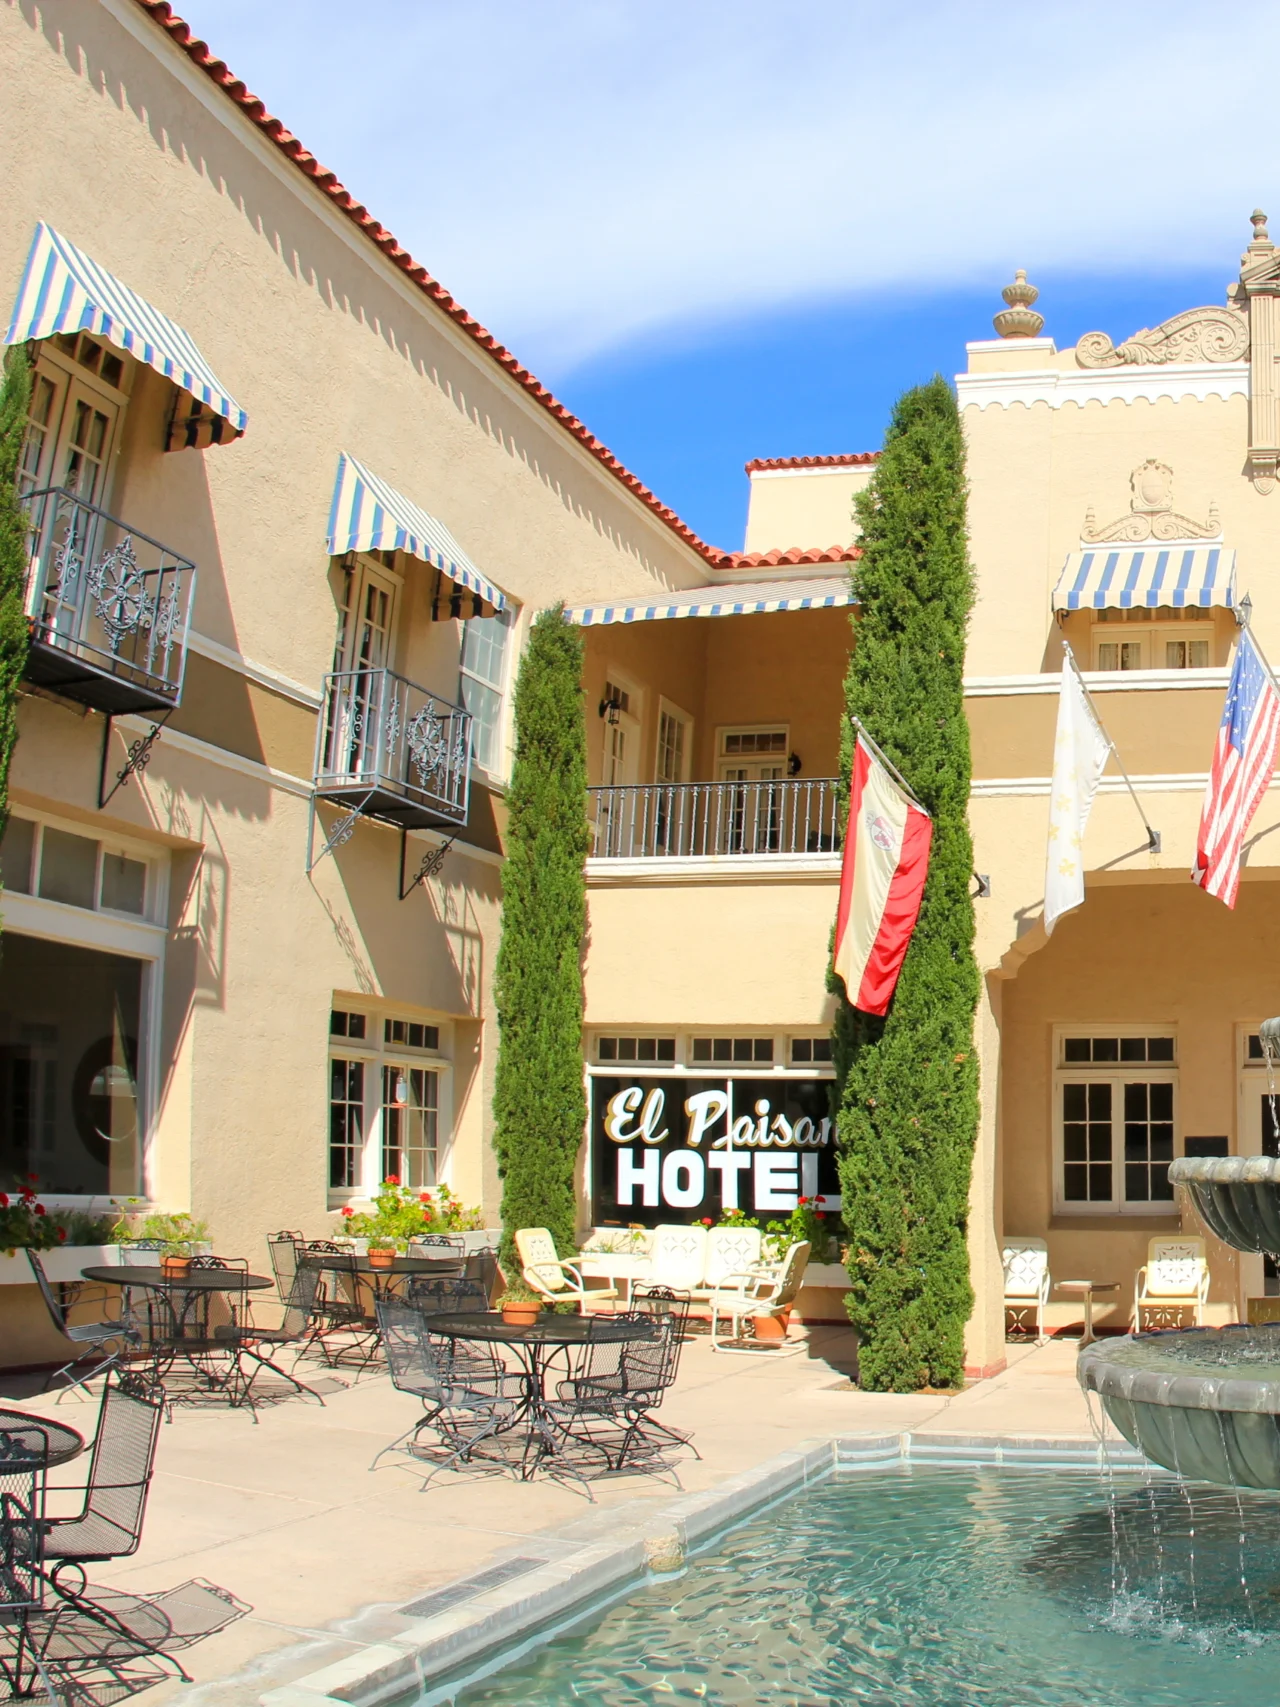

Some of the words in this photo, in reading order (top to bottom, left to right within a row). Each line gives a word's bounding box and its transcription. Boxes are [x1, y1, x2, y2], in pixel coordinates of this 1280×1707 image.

[604, 1086, 669, 1144] El
[684, 1089, 841, 1149] Paisan
[617, 1148, 842, 1212] HOTEL
